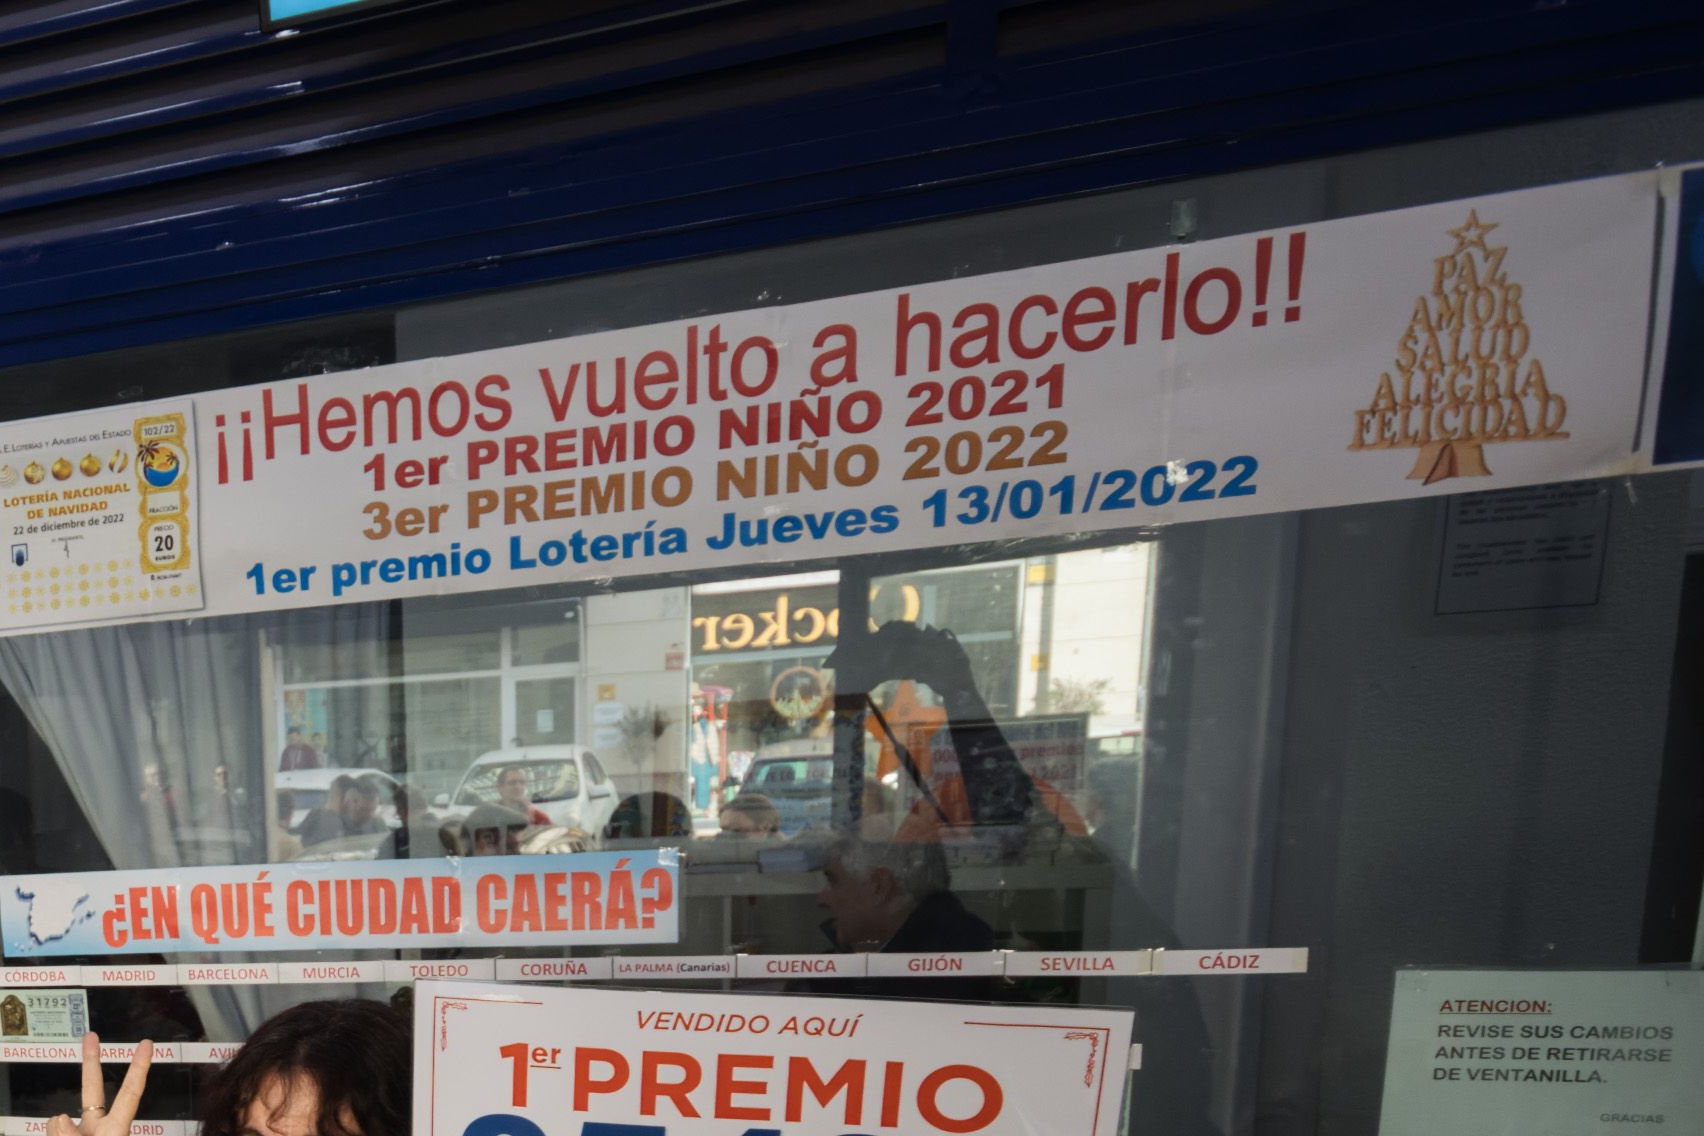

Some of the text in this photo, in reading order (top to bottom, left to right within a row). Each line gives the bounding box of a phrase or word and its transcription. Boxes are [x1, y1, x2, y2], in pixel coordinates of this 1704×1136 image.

[215, 232, 1307, 485] ¡¡Hemos vuelto a hacerlo!!
[363, 364, 1065, 492] 1er PREMIO NIÑO 2021
[363, 420, 1069, 541] 3er PREMIO NIÑO 2022
[3, 483, 131, 508] LOTERÍA NACIONAL
[27, 500, 108, 520] DE NAVIDAD
[13, 513, 125, 535] 22 de diciembre de 2022
[247, 455, 1260, 596] 1er premio Lotería Jueves 13/01/2022
[154, 535, 174, 552] 20
[102, 858, 673, 948] ¿EN QUÉ CIUDAD CAERÁ?
[521, 960, 587, 976] CORUÑA
[620, 961, 731, 975] LA PALMA (Canarias)
[766, 959, 837, 974] CUENCA
[907, 954, 963, 972] GIJÓN
[1040, 956, 1115, 971] SEVILLA
[1199, 952, 1260, 970] CÁDIZ
[4, 967, 66, 982] CÓRDOBA
[102, 970, 155, 982] MADRID
[188, 967, 269, 980] BARCELONA
[303, 966, 360, 979] MURCIA
[410, 965, 468, 978] TOLEDO
[28, 998, 67, 1008] 31792
[1440, 1000, 1552, 1014] ATENCION:
[637, 1009, 865, 1038] VENDIDO AQUÍ
[1437, 1025, 1674, 1040] REVISE SUS CAMBIOS
[4, 1046, 76, 1058] BARCELONA
[1435, 1047, 1672, 1063] ANTES DE RETIRARSE
[1433, 1068, 1608, 1084] DE VENTANILLA.
[572, 1048, 1005, 1134] PREMIO
[1600, 1113, 1665, 1124] GRACIAS
